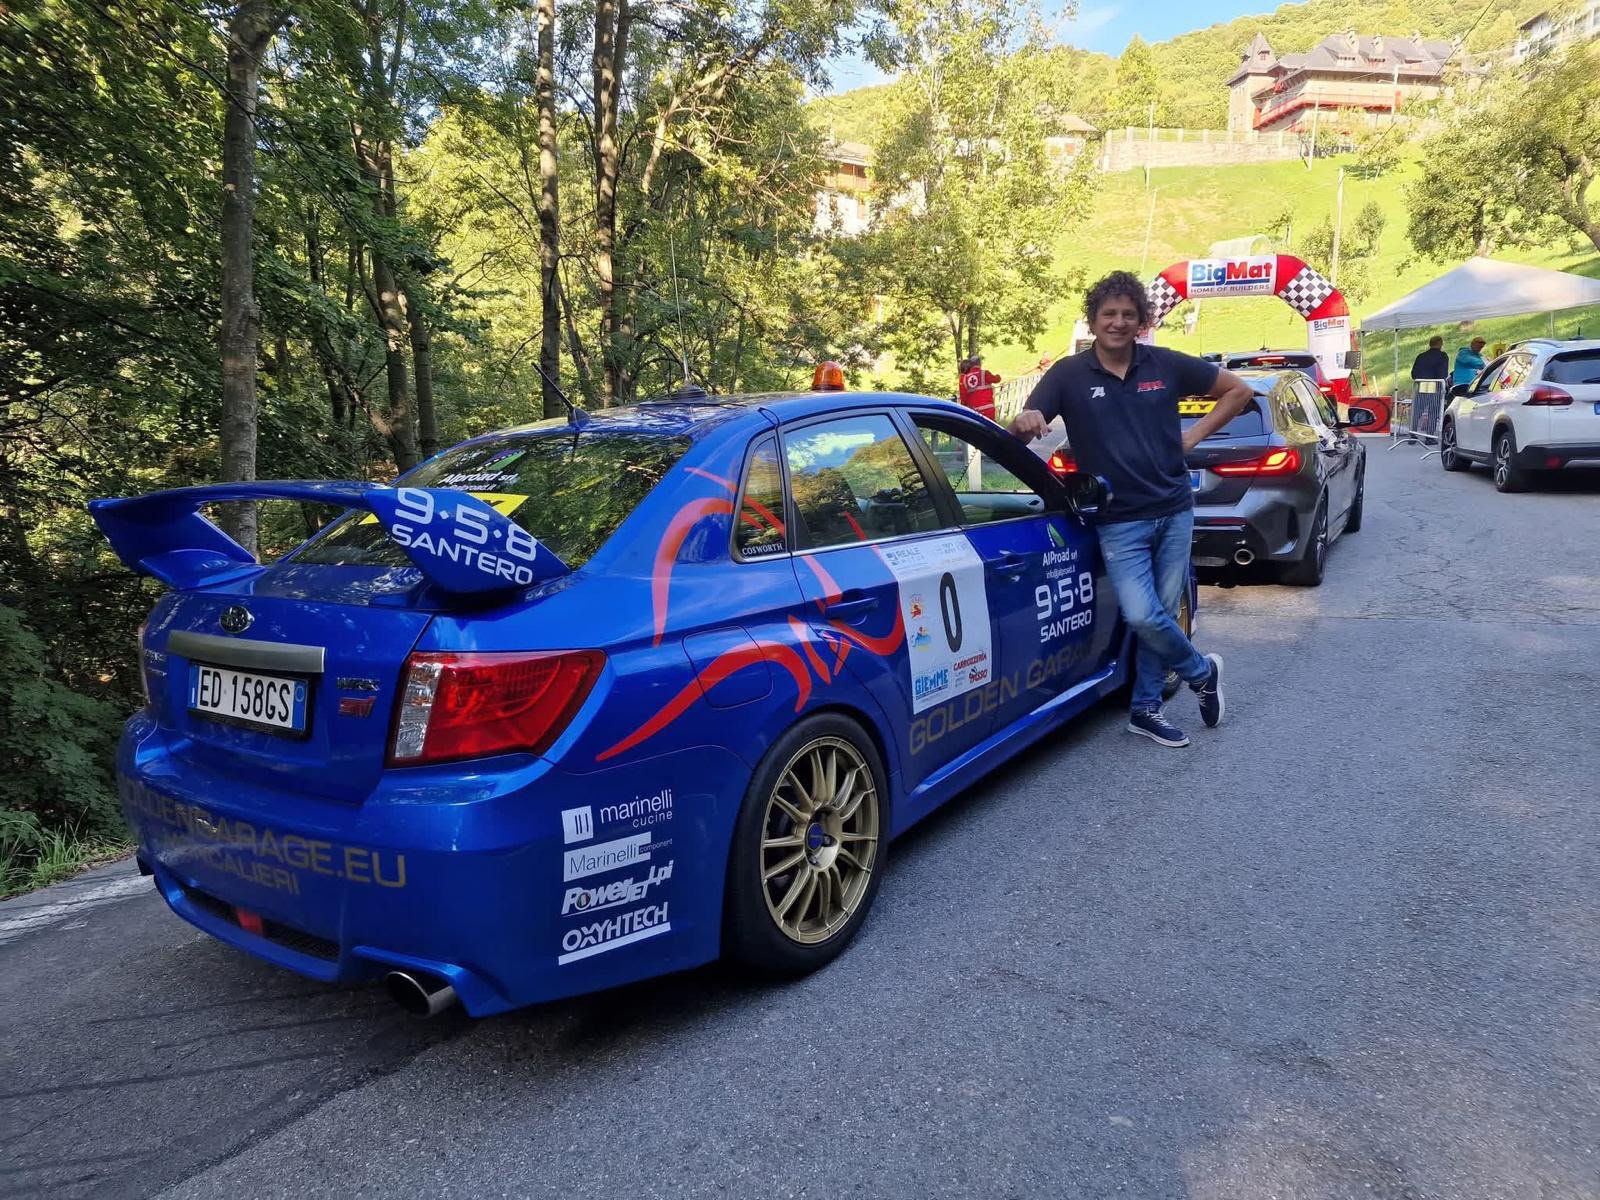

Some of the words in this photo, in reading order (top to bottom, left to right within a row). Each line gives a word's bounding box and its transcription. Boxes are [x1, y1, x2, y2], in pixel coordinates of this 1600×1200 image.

[1191, 261, 1273, 285] BigMat
[1230, 284, 1270, 292] BUILDERS
[1314, 319, 1345, 330] BigMat
[392, 523, 533, 585] SANTERO
[741, 542, 783, 556] COSWORTH
[939, 571, 963, 653] 0
[1040, 609, 1092, 643] SANTERO
[199, 669, 222, 708] ED
[231, 674, 291, 723] 158GS
[915, 668, 949, 695] GIEMME
[909, 670, 1020, 756] GOLDEN
[600, 788, 673, 824] marinelli
[632, 810, 673, 829] cucine
[569, 843, 637, 875] Marinelli
[562, 900, 669, 952] OXYHTECH
